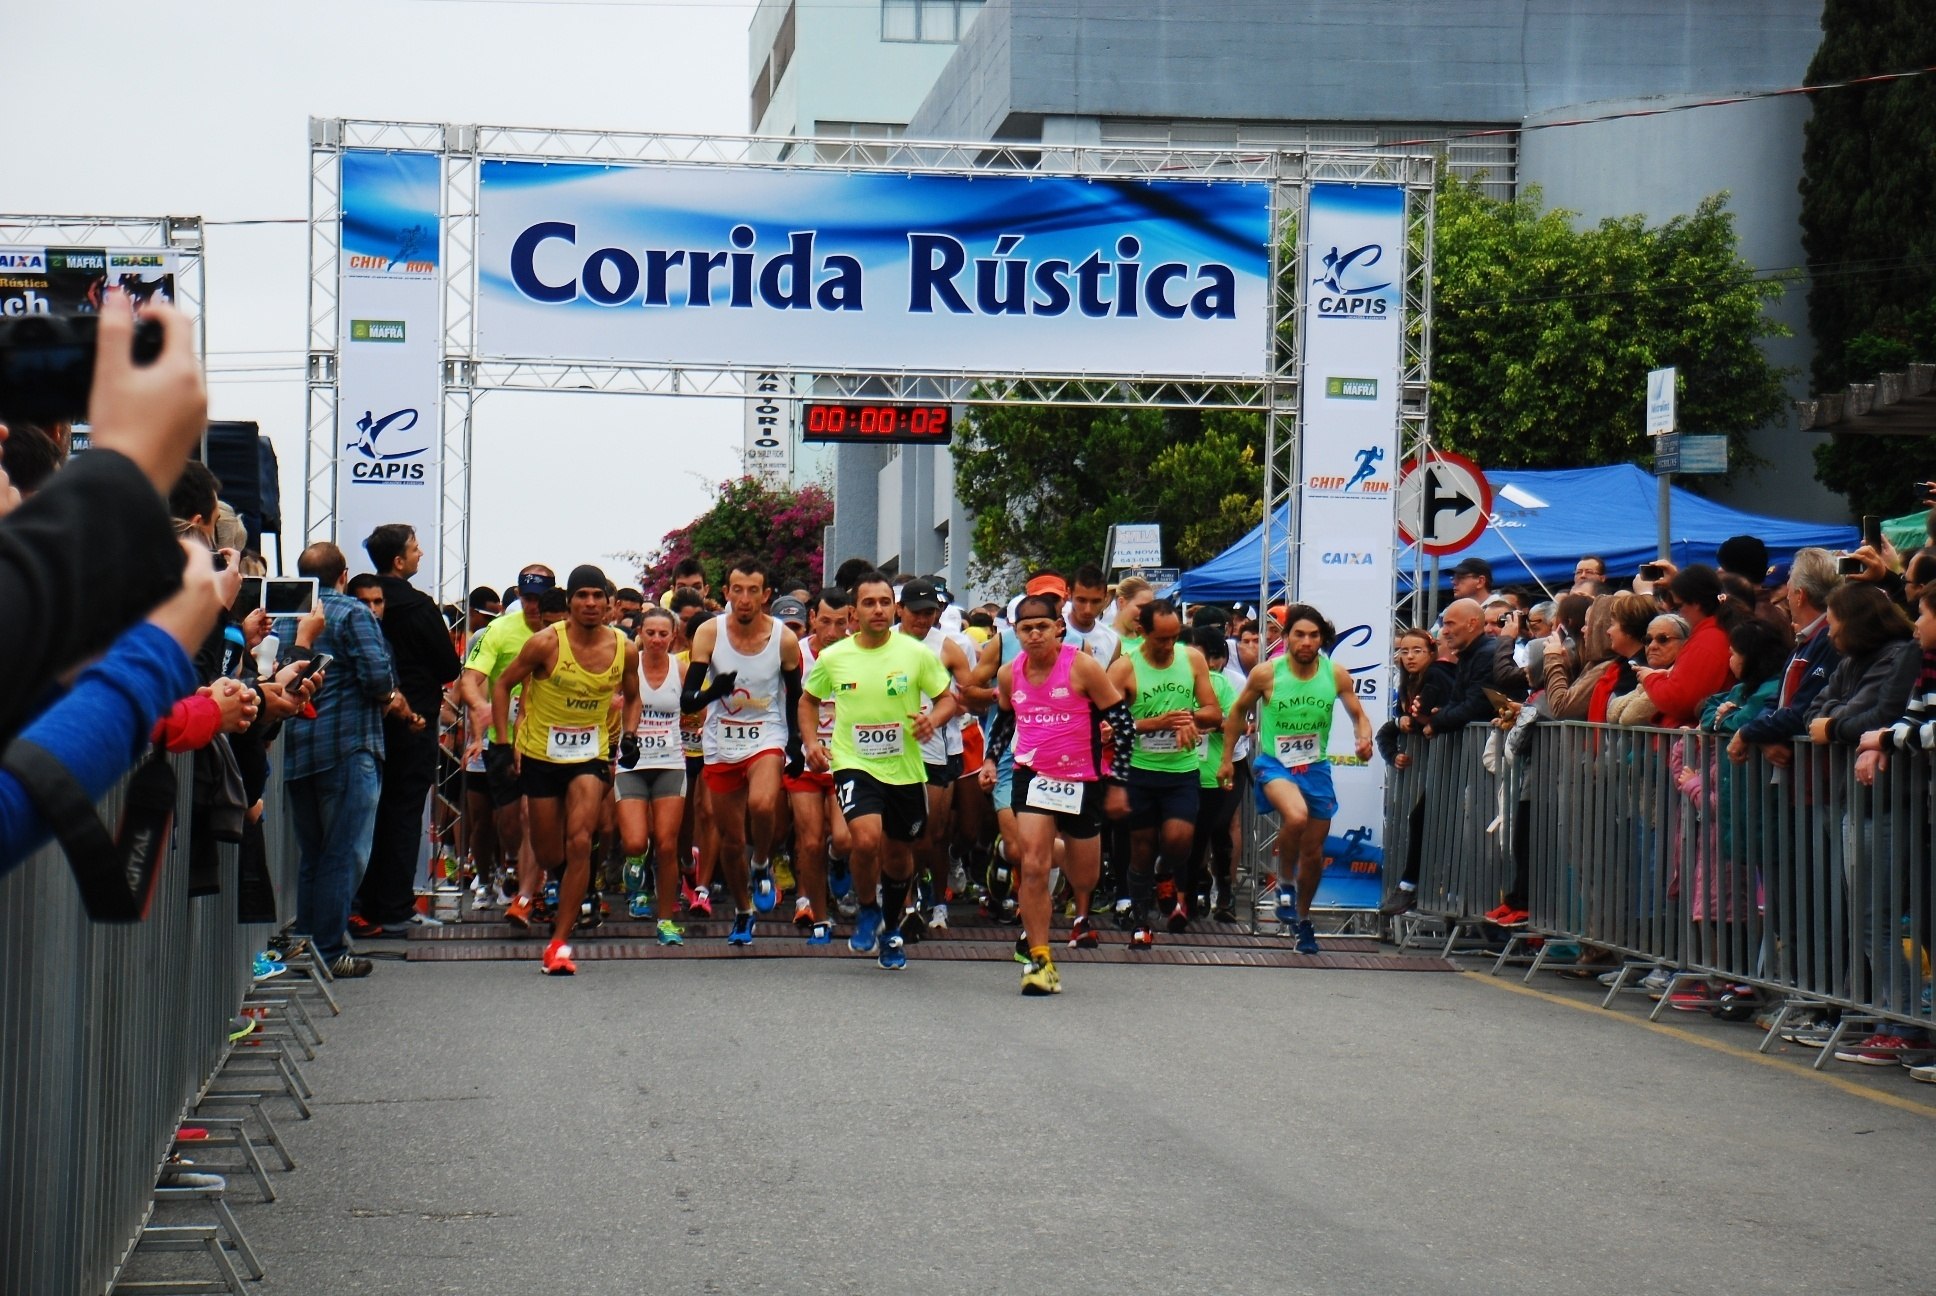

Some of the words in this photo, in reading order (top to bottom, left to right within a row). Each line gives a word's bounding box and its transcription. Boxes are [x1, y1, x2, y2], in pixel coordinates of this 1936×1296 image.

[0, 256, 42, 267] AIXA
[66, 257, 104, 268] MAFRA
[110, 257, 163, 267] BRASIL
[350, 256, 388, 269] CHIP
[406, 261, 434, 273] RUN
[510, 221, 864, 312] Corrida
[907, 233, 1237, 320] Rústica
[0, 277, 48, 288] Rústica
[0, 290, 51, 316] ch
[1317, 297, 1387, 314] CAPIS
[369, 327, 404, 338] MAFRA
[1343, 385, 1375, 396] MAFRA
[808, 405, 947, 434] 00:00:02
[352, 462, 425, 480] CAPIS
[1309, 476, 1345, 489] CHIP
[1362, 480, 1389, 492] RUN
[1321, 552, 1373, 565] CAIXA
[1142, 682, 1191, 703] AMIGOS
[566, 698, 599, 711] VIGA
[1278, 696, 1332, 713] AMIGOS
[554, 732, 591, 746] 019
[724, 726, 760, 740] 116
[858, 729, 897, 744] 206
[1280, 739, 1314, 754] 246
[1036, 778, 1075, 796] 236
[1350, 861, 1378, 873] RUN
